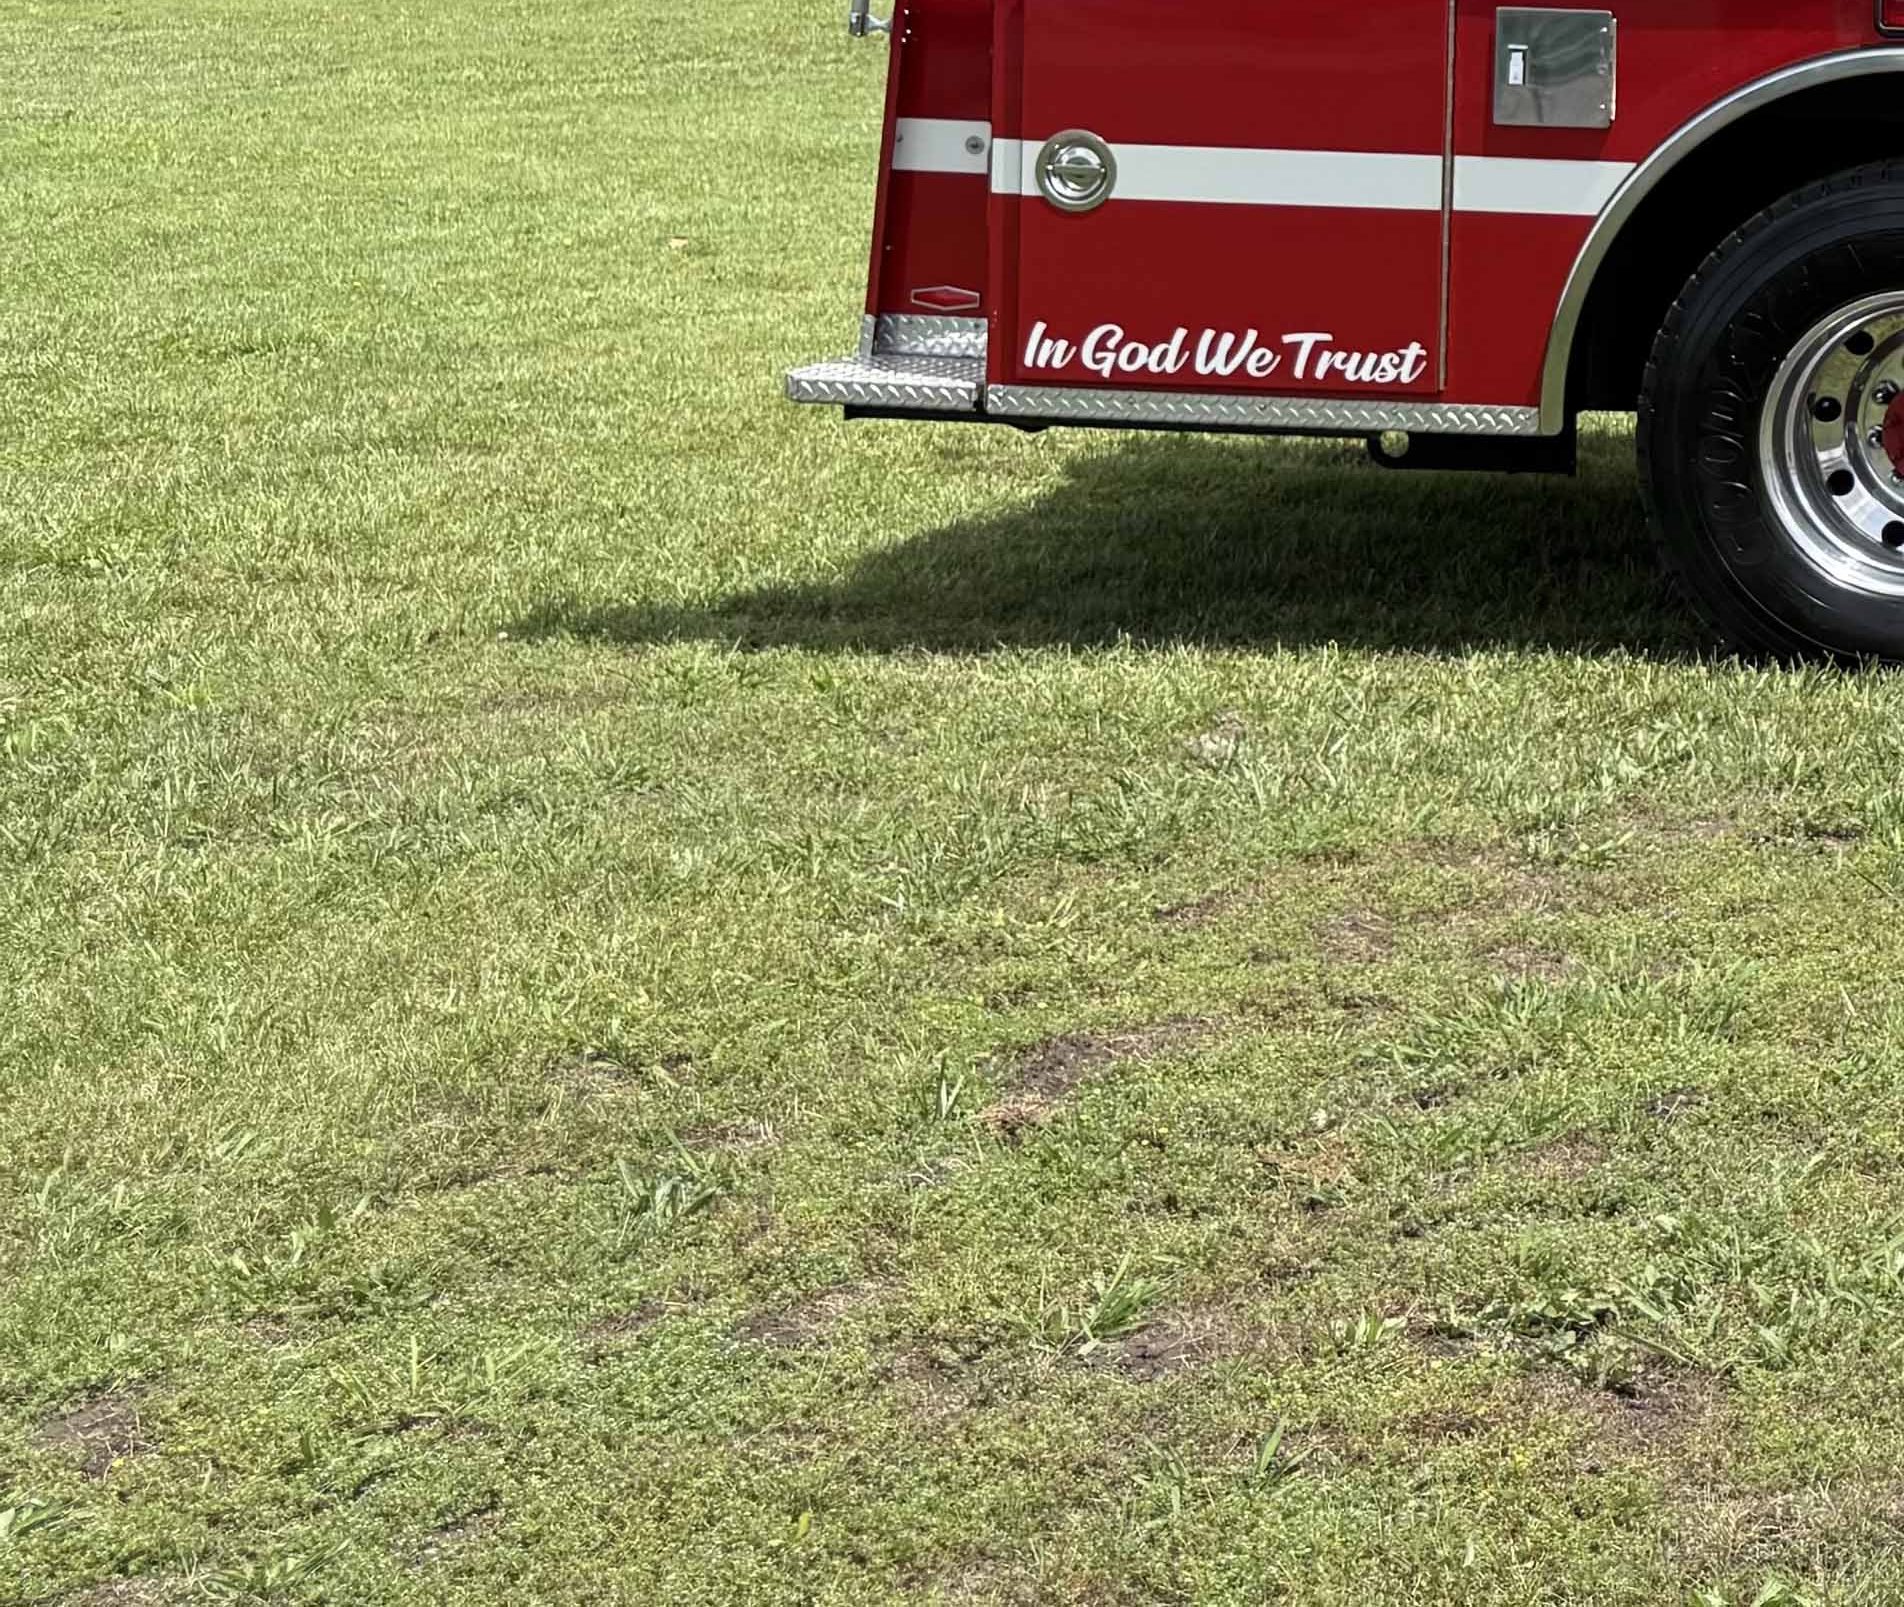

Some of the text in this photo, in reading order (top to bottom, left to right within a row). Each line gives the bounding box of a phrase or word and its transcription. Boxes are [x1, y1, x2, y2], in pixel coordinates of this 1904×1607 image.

[1023, 321, 1427, 384] In God We Trust
